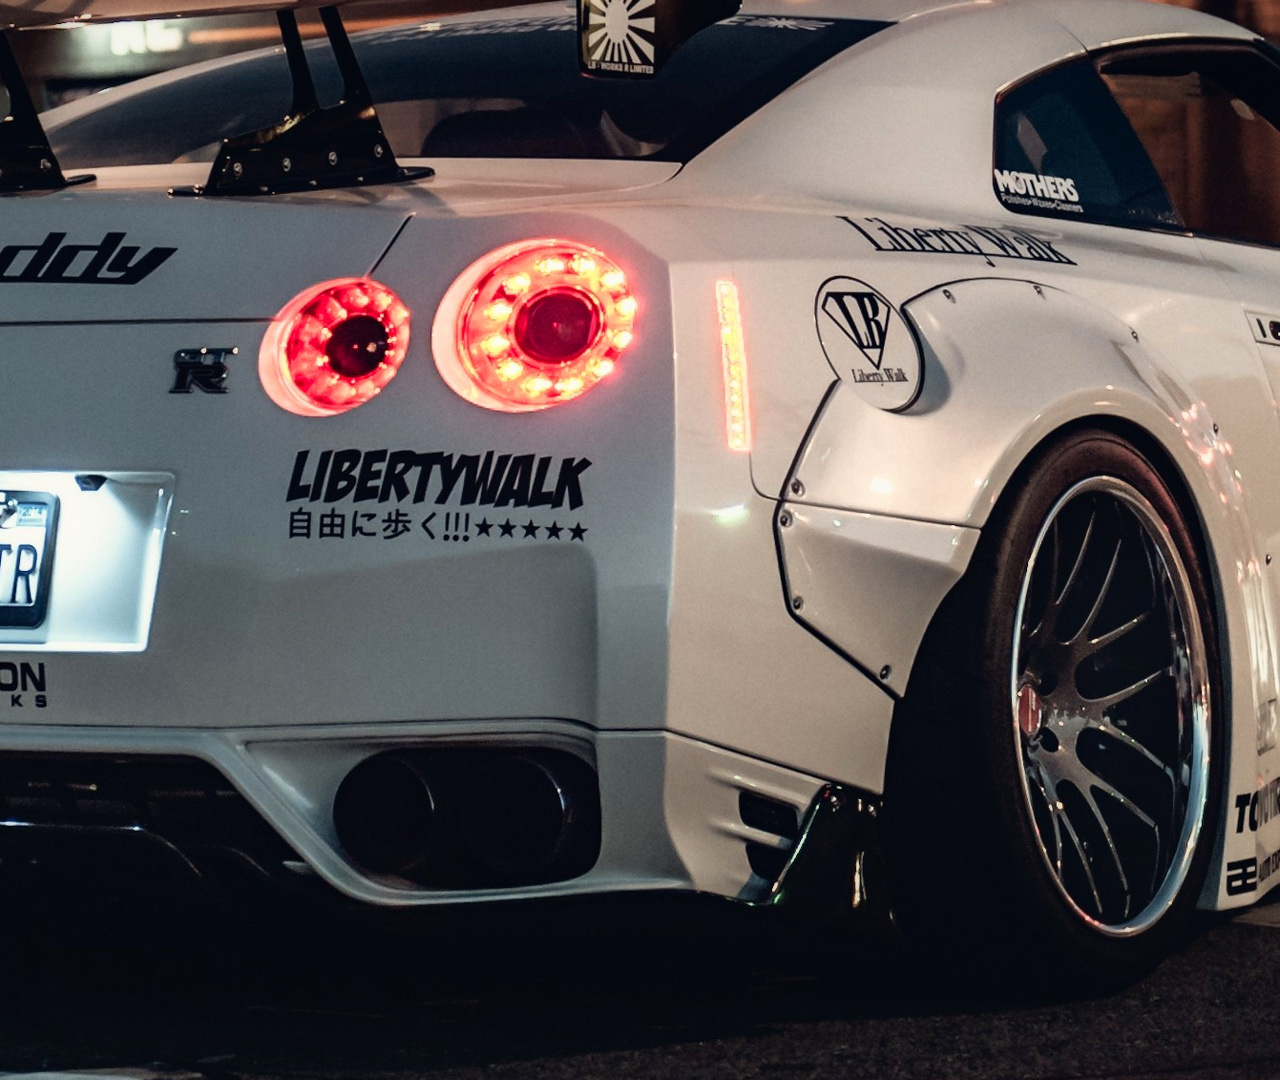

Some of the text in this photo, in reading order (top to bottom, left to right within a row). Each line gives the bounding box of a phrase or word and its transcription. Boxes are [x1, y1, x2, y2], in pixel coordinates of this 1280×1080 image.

[994, 169, 1079, 202] MOTHERS
[834, 216, 1078, 267] Liberty Walk
[851, 368, 908, 386] Liberty Walk
[286, 449, 592, 511] LIBERTYWALK
